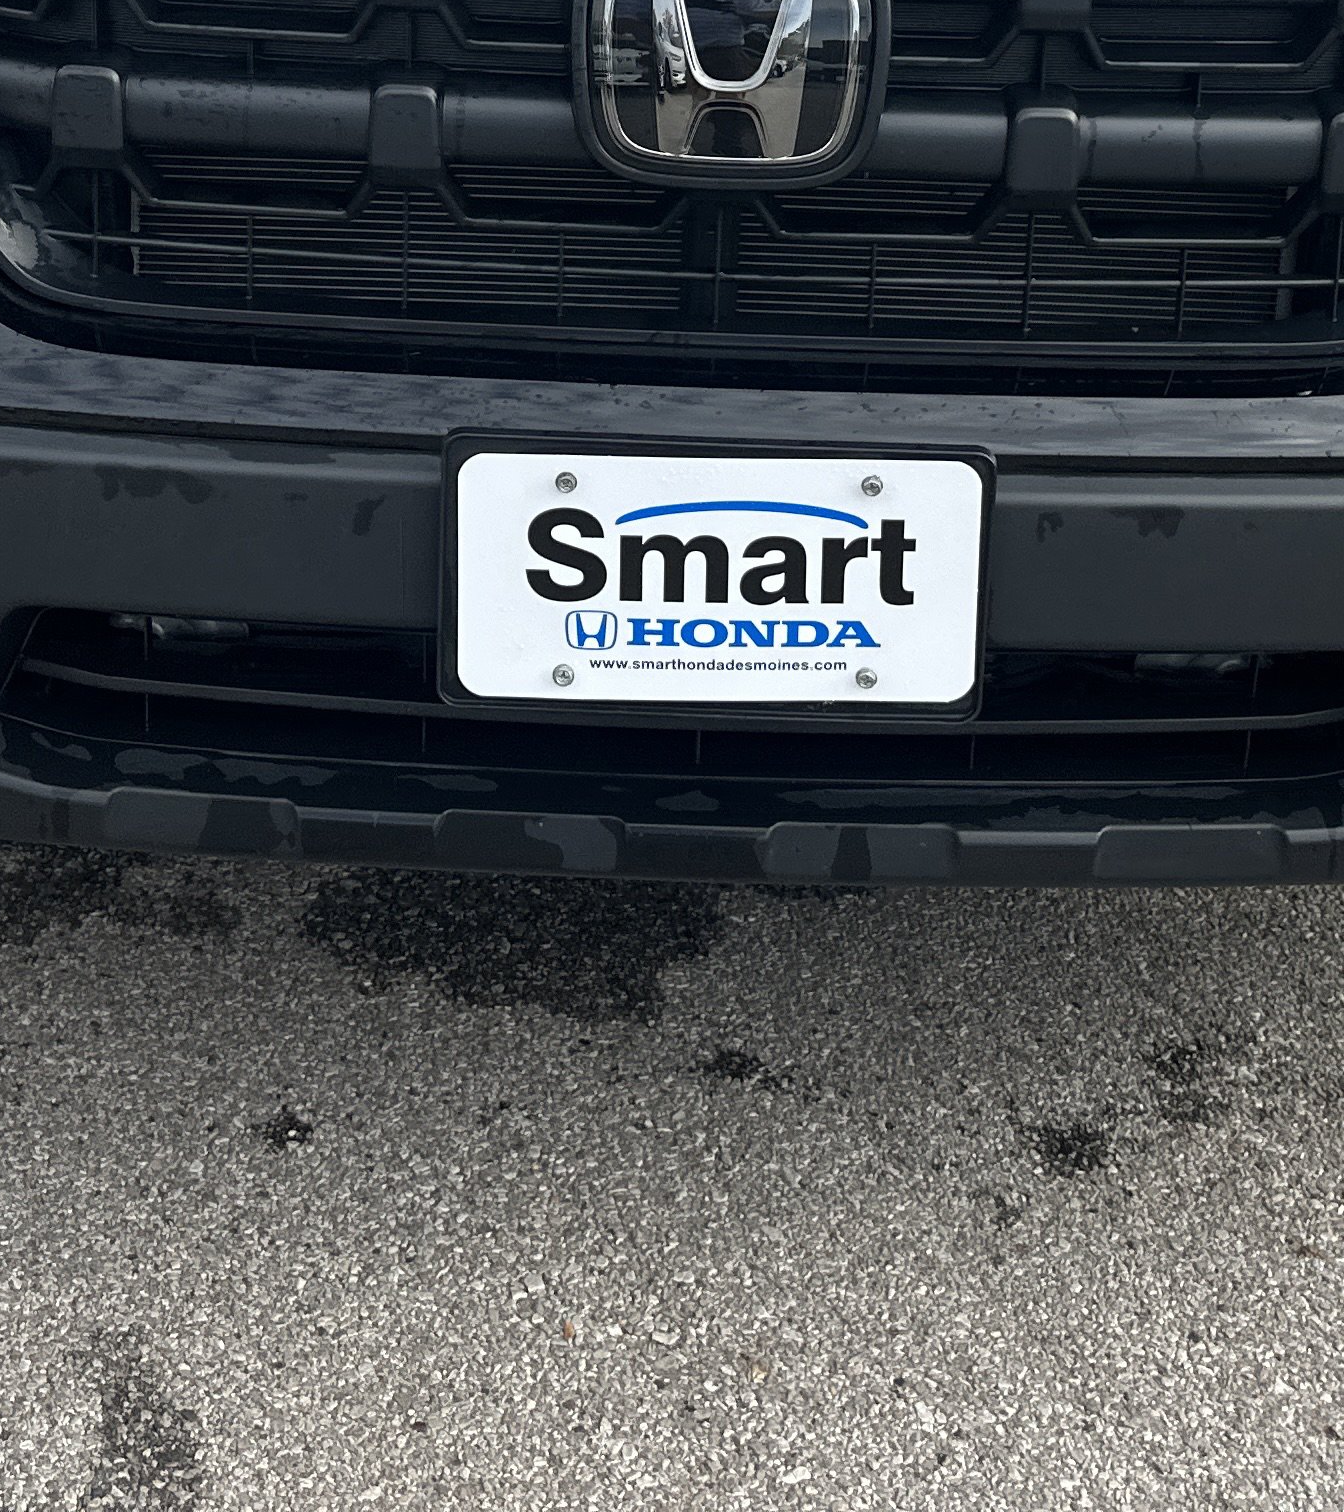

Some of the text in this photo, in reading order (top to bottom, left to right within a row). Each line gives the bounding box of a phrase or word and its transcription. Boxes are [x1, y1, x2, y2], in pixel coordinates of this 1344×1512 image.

[525, 507, 916, 605] Smart
[626, 618, 881, 648] HONDA
[589, 657, 847, 672] www.smarthondadesmoines.com
